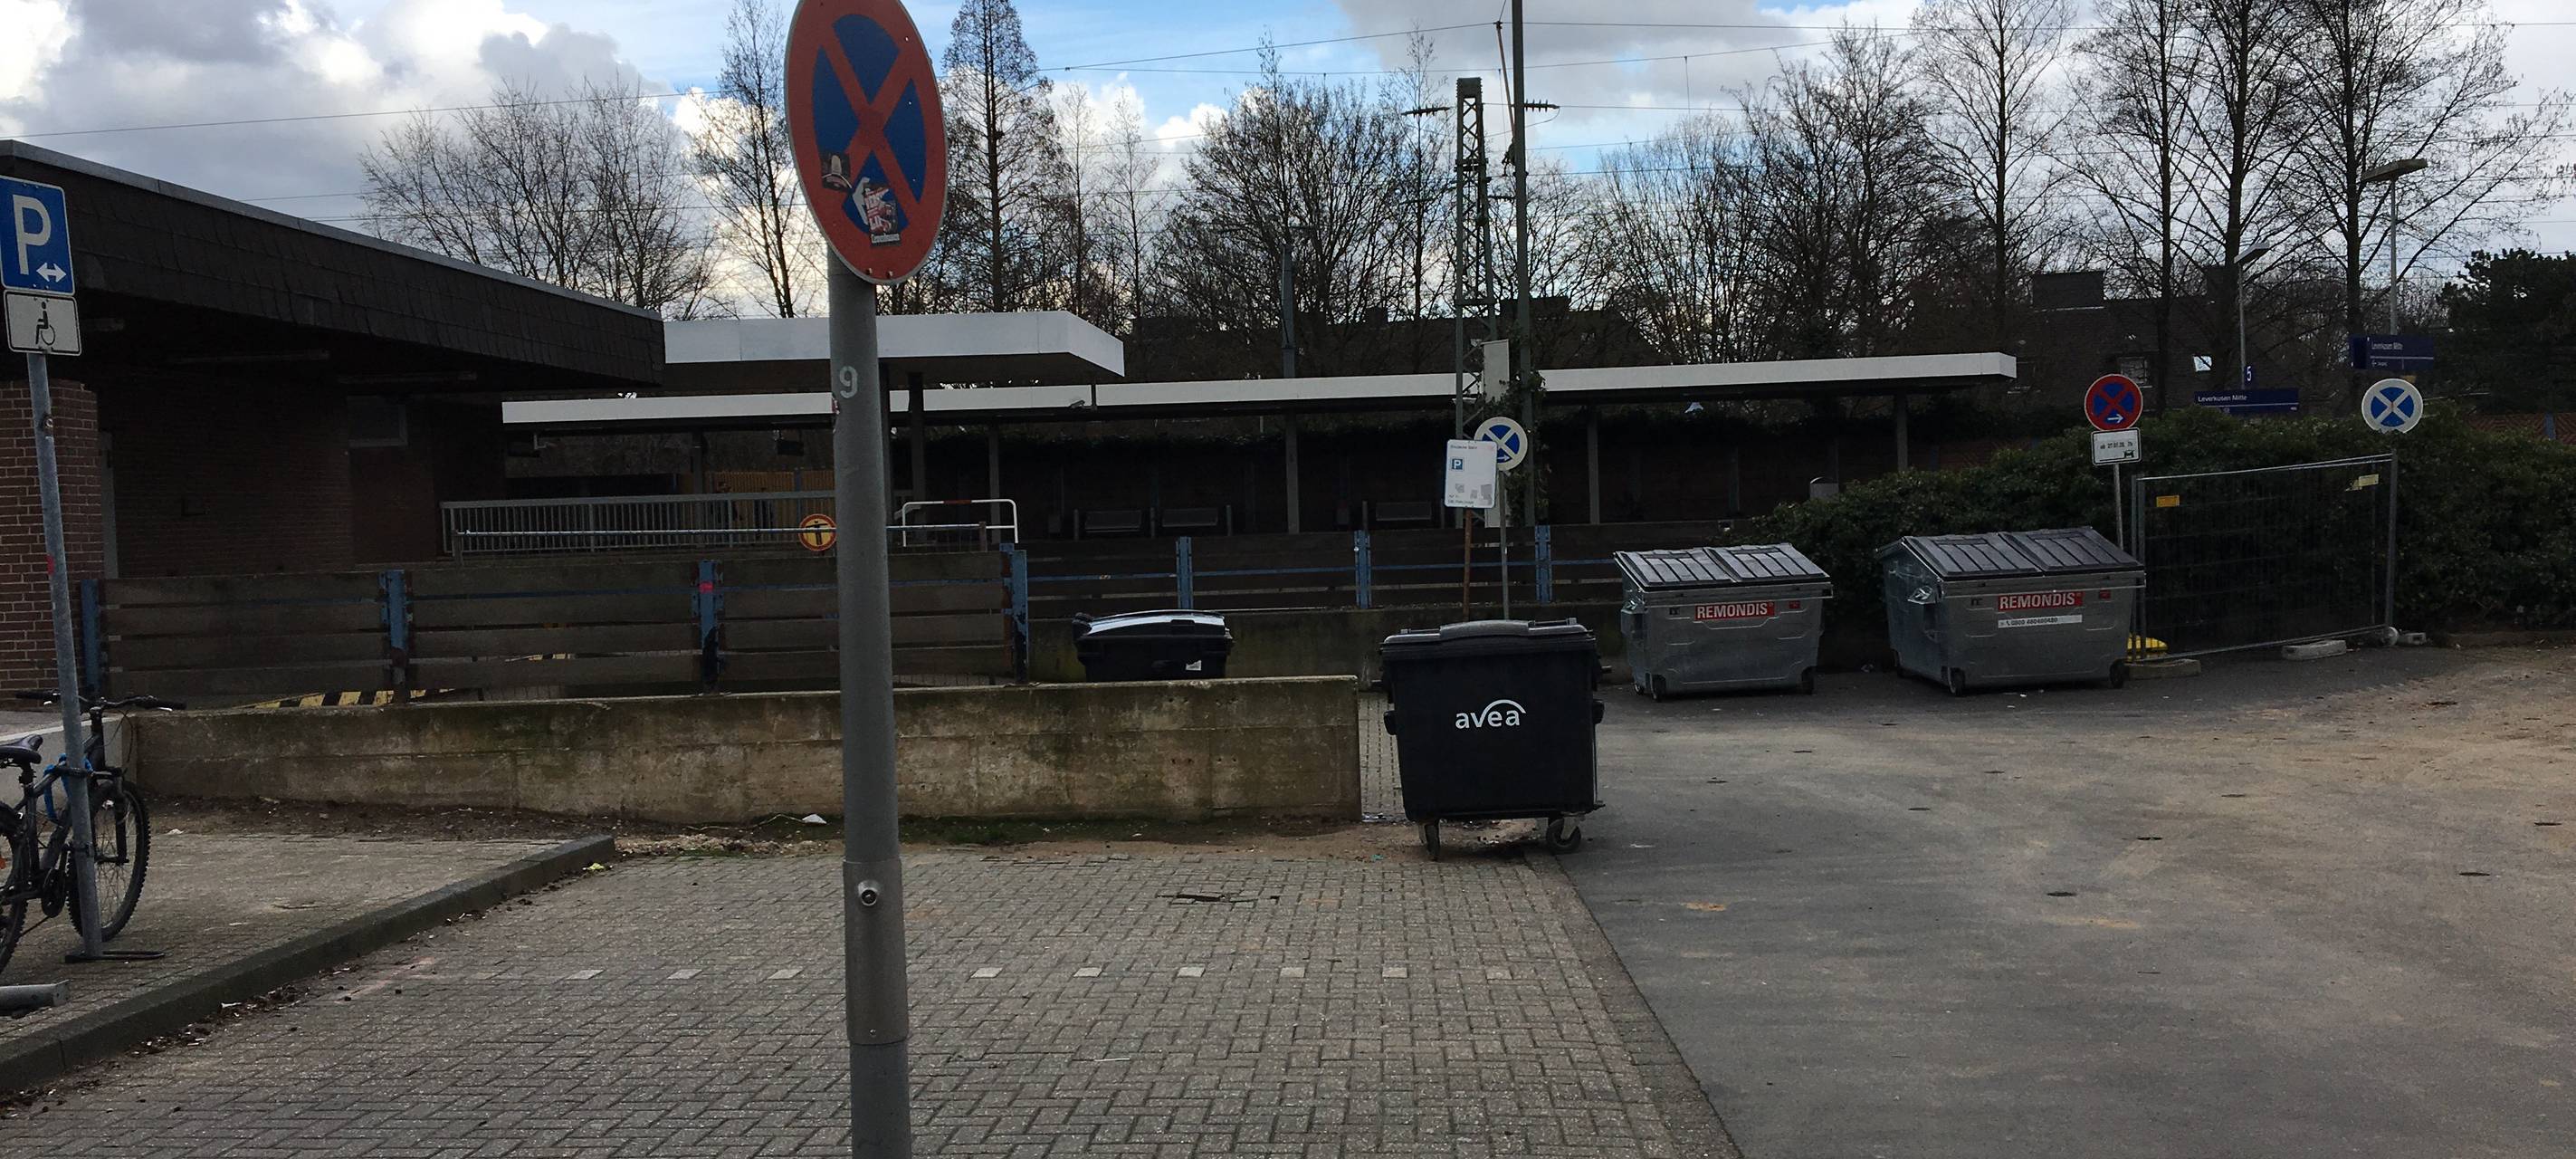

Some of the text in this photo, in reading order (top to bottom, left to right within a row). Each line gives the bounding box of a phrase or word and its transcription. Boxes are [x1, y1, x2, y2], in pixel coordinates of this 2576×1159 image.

[13, 194, 52, 275] P
[2247, 365, 2252, 381] 5
[839, 366, 858, 398] 9
[1454, 459, 1462, 469] P
[1999, 592, 2075, 609] REMONDIS
[1697, 602, 1768, 618] REMONDIS
[1455, 699, 1526, 729] avea
